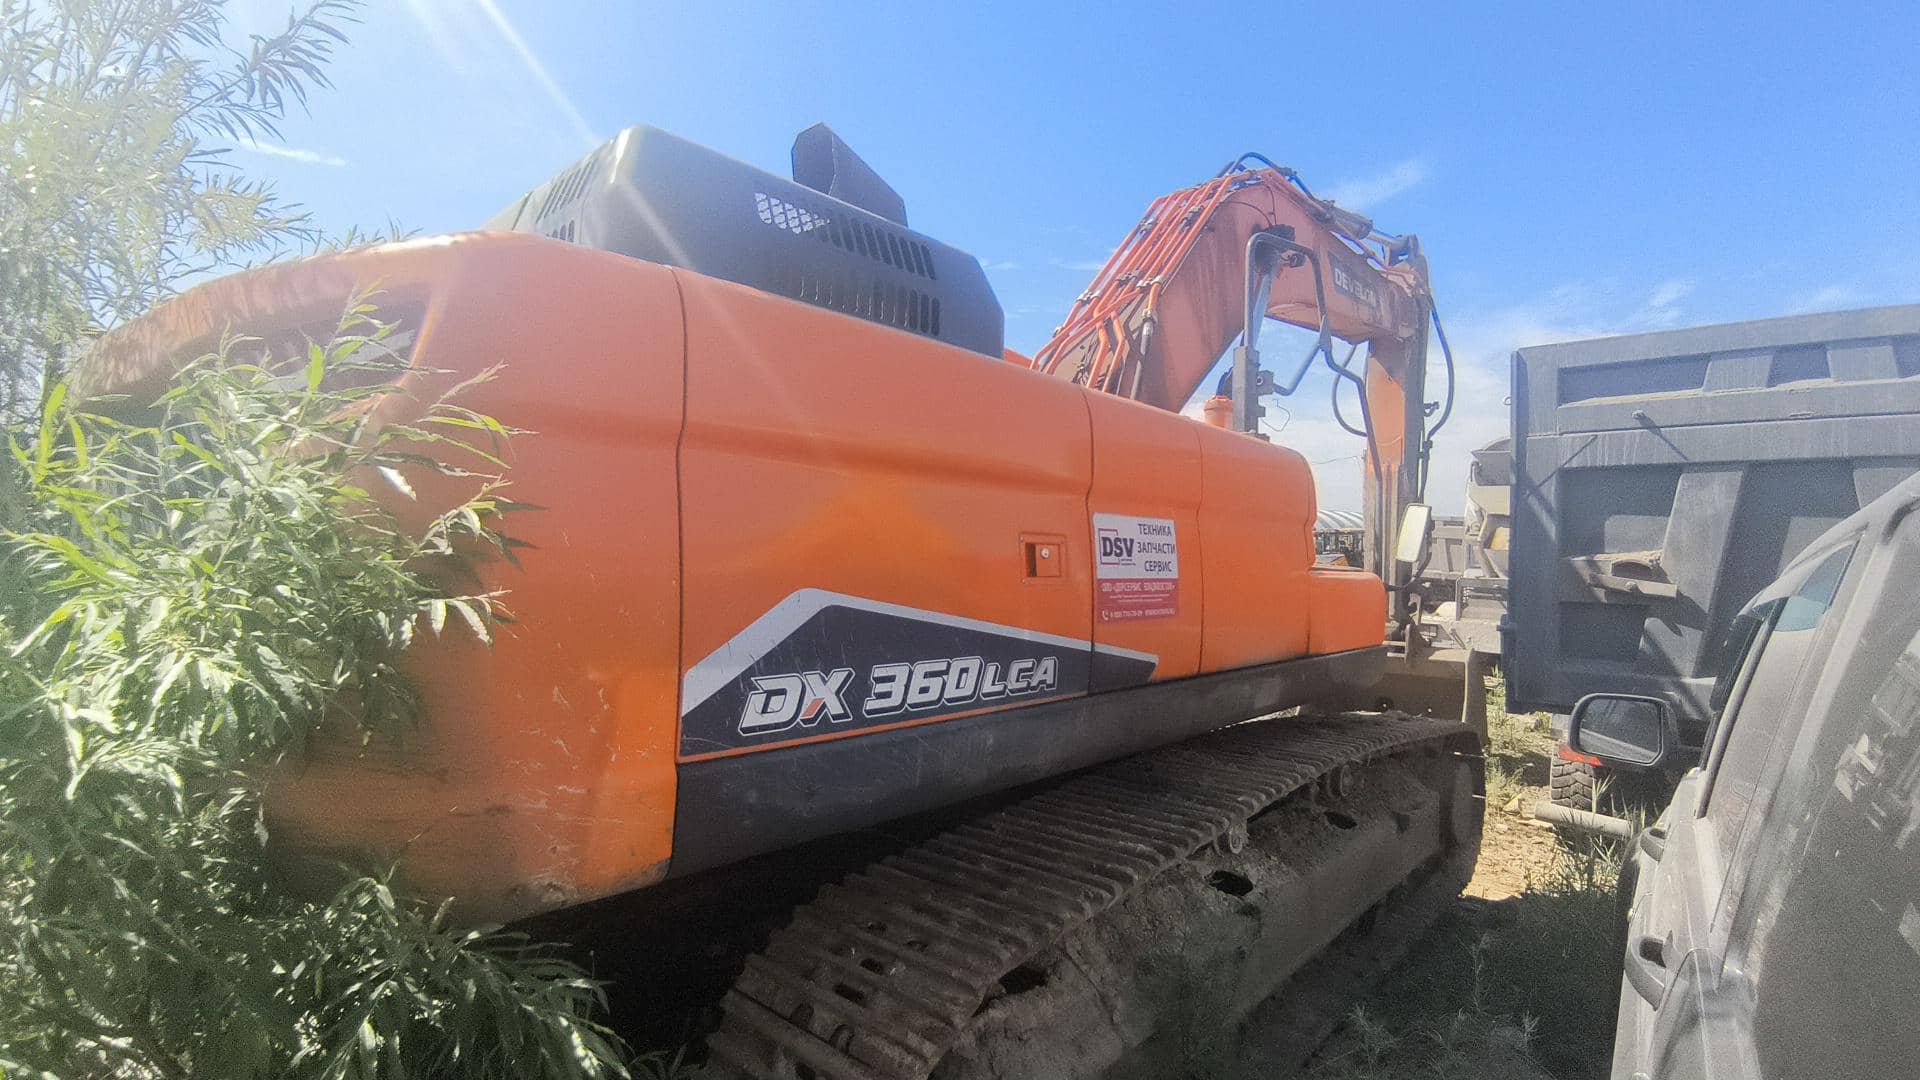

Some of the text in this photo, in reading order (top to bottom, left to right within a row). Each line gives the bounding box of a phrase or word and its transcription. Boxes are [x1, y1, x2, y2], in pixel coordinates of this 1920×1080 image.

[1138, 523, 1172, 537] ТЕХНИКА
[1101, 536, 1134, 558] DSV
[1137, 541, 1176, 554] ЗАПЧАСТИ
[1144, 560, 1172, 572] СЕРВИС
[738, 655, 1058, 736] DX 360LCA
